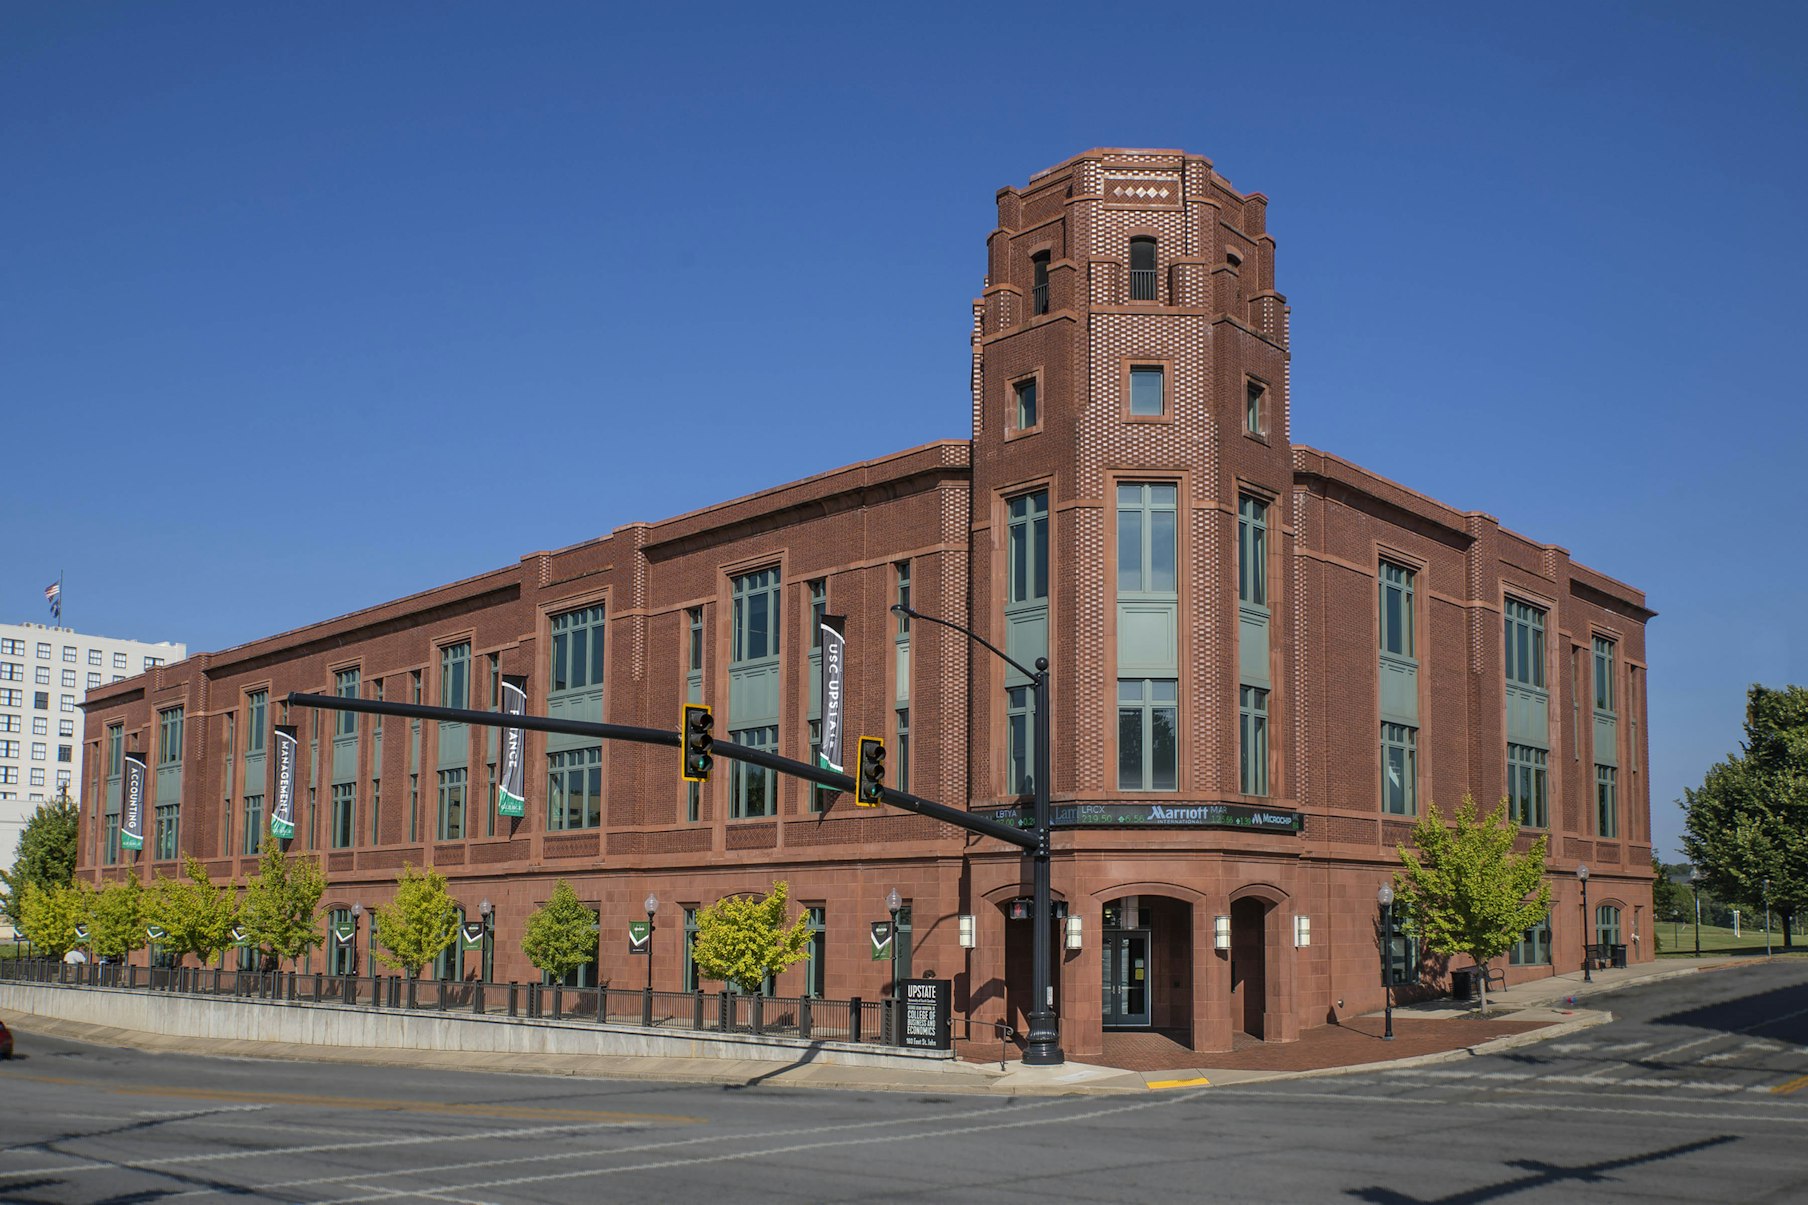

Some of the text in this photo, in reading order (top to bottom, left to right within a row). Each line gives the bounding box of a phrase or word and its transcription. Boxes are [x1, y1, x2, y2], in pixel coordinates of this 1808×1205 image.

[828, 644, 838, 674] USC
[508, 709, 519, 768] FANCE
[279, 741, 290, 814] MANAGEMENT
[128, 767, 139, 829] ACCOUNTING
[995, 809, 1017, 819] LBTYA
[1081, 805, 1105, 814] LRCX
[1147, 805, 1209, 820] Marriott
[1210, 805, 1228, 814] MAR
[1081, 814, 1113, 823] 219.50
[907, 985, 936, 998] UPSTATE
[907, 1010, 936, 1020] COLLEGE OF
[927, 1019, 936, 1027] AND
[907, 1026, 936, 1036] ECONOMICS
